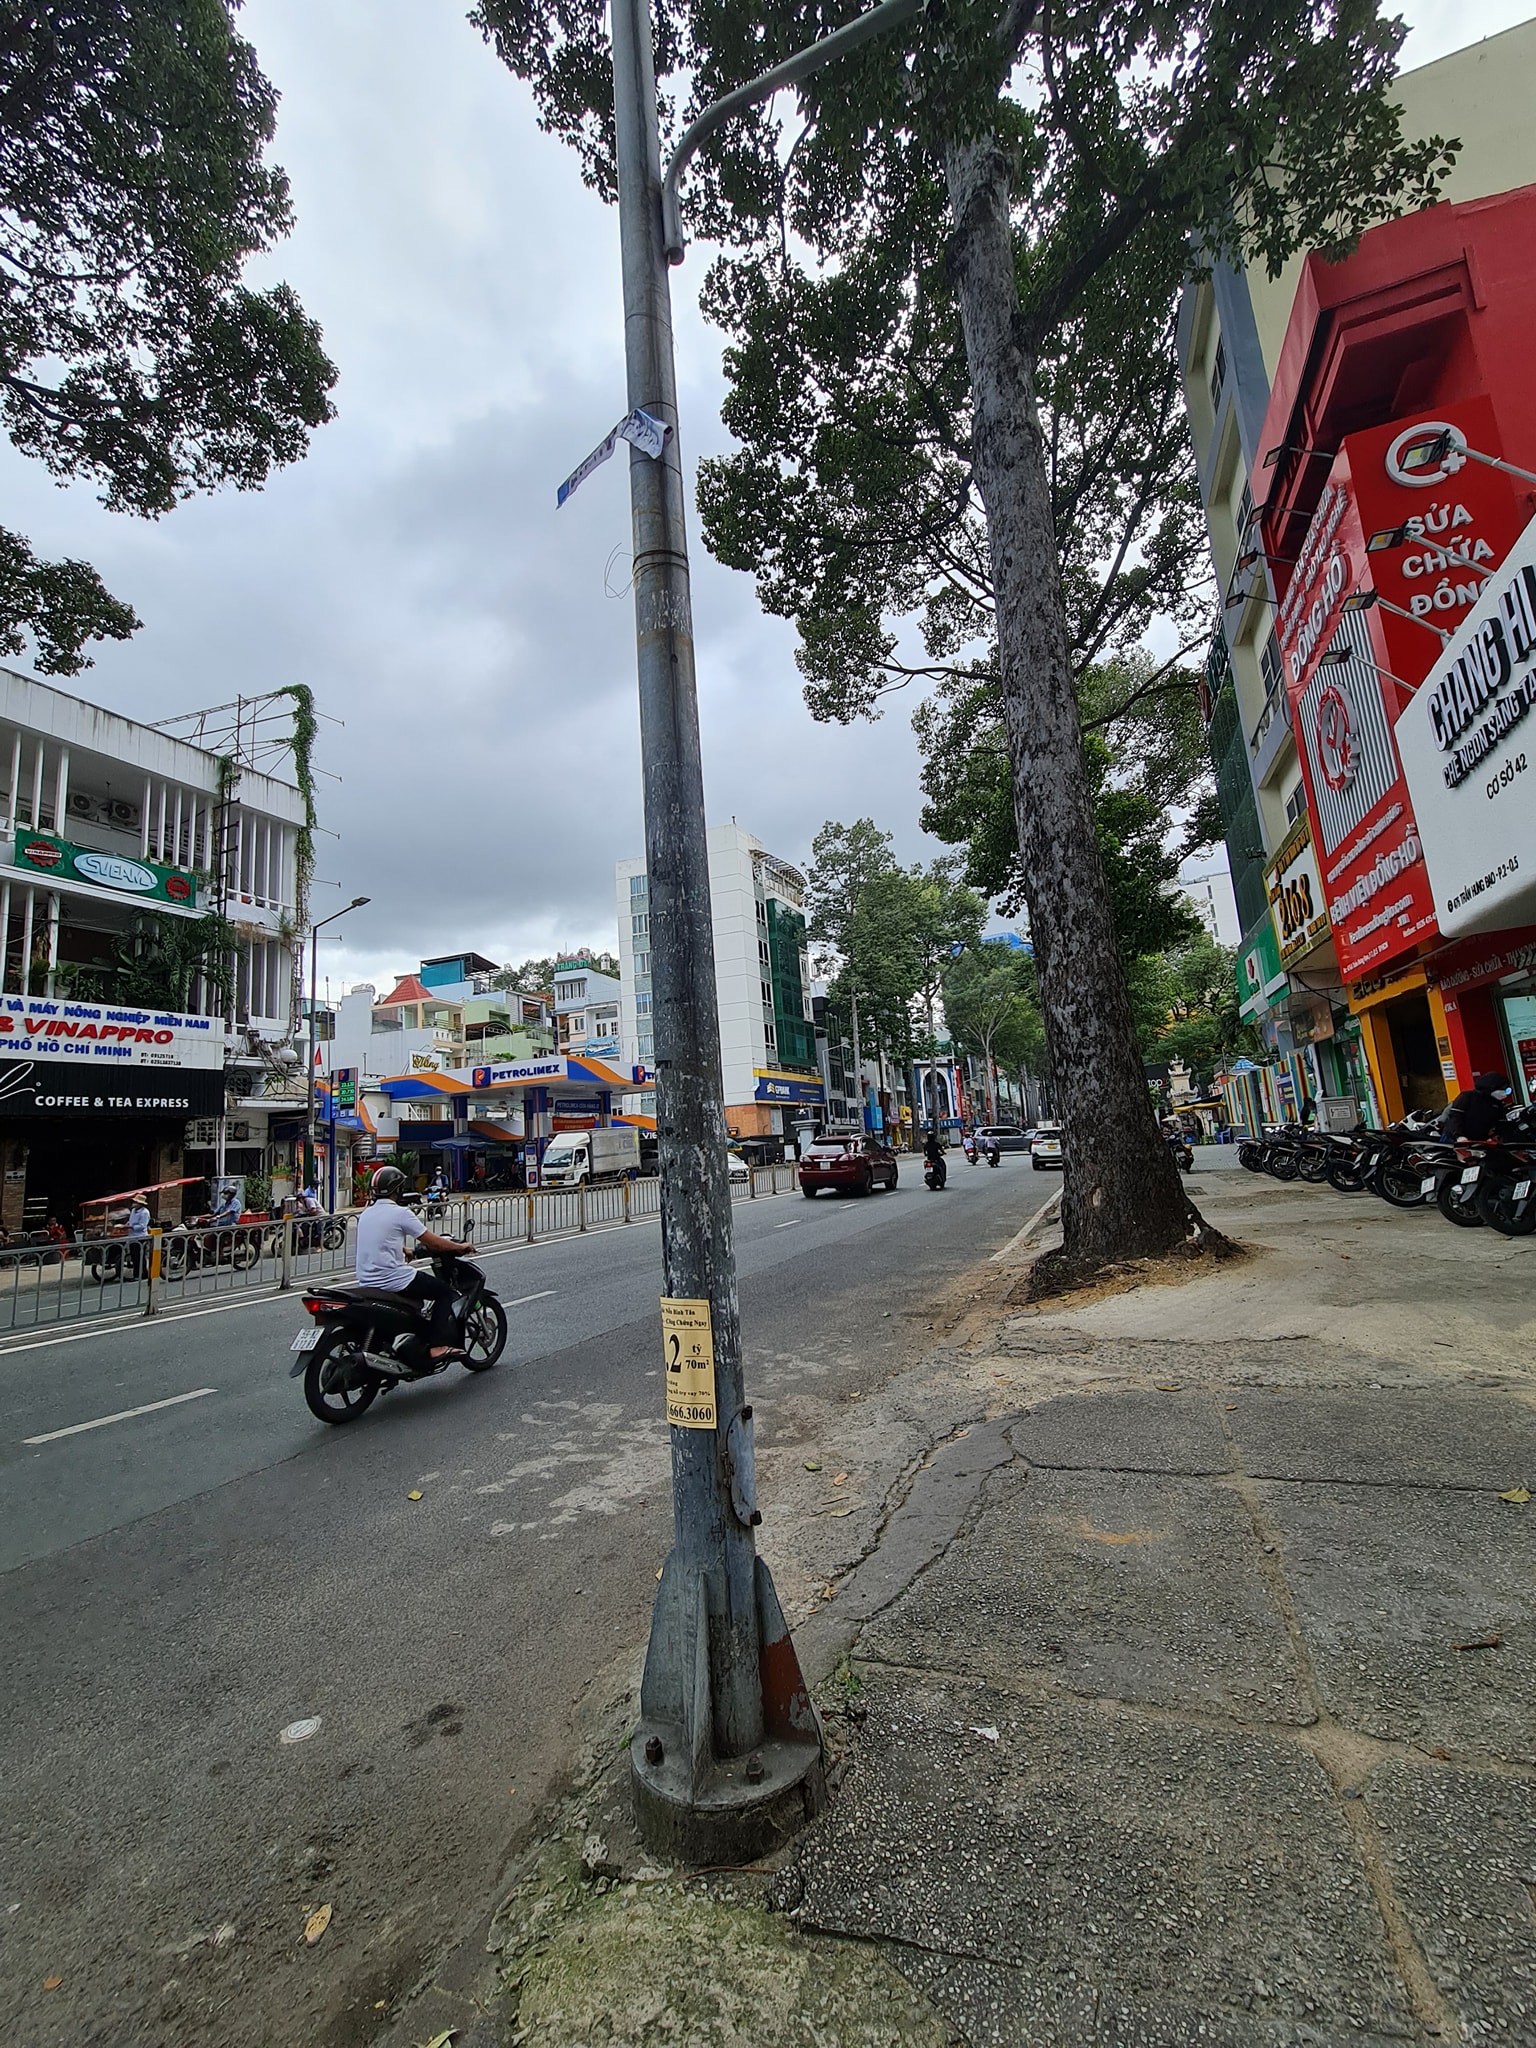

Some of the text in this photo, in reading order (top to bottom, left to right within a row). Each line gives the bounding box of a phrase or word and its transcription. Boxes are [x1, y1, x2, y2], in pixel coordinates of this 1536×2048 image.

[1407, 502, 1474, 537] SỬA
[1402, 535, 1495, 579] CHỮA
[1291, 599, 1324, 684] ĐỒNG
[1322, 540, 1347, 617] HỒ
[1426, 617, 1507, 753] CHANG
[1486, 753, 1528, 800] CƠ SỞ 42
[1329, 894, 1353, 926] BỆNH
[1349, 874, 1372, 908] VIỆN
[1369, 852, 1399, 892] ĐỒNG
[1398, 823, 1421, 869] HỒ
[7, 998, 209, 1030] VÀ MÁY NÔNG NGHIỆP MIỀN NAM
[24, 1017, 174, 1045] VINAPPRO
[0, 1035, 132, 1057] PHỐ HỒ CHÍ MINH
[492, 1063, 560, 1081] PETROLIMEX
[35, 1095, 189, 1108] COFFEE & TEA EXPRESS
